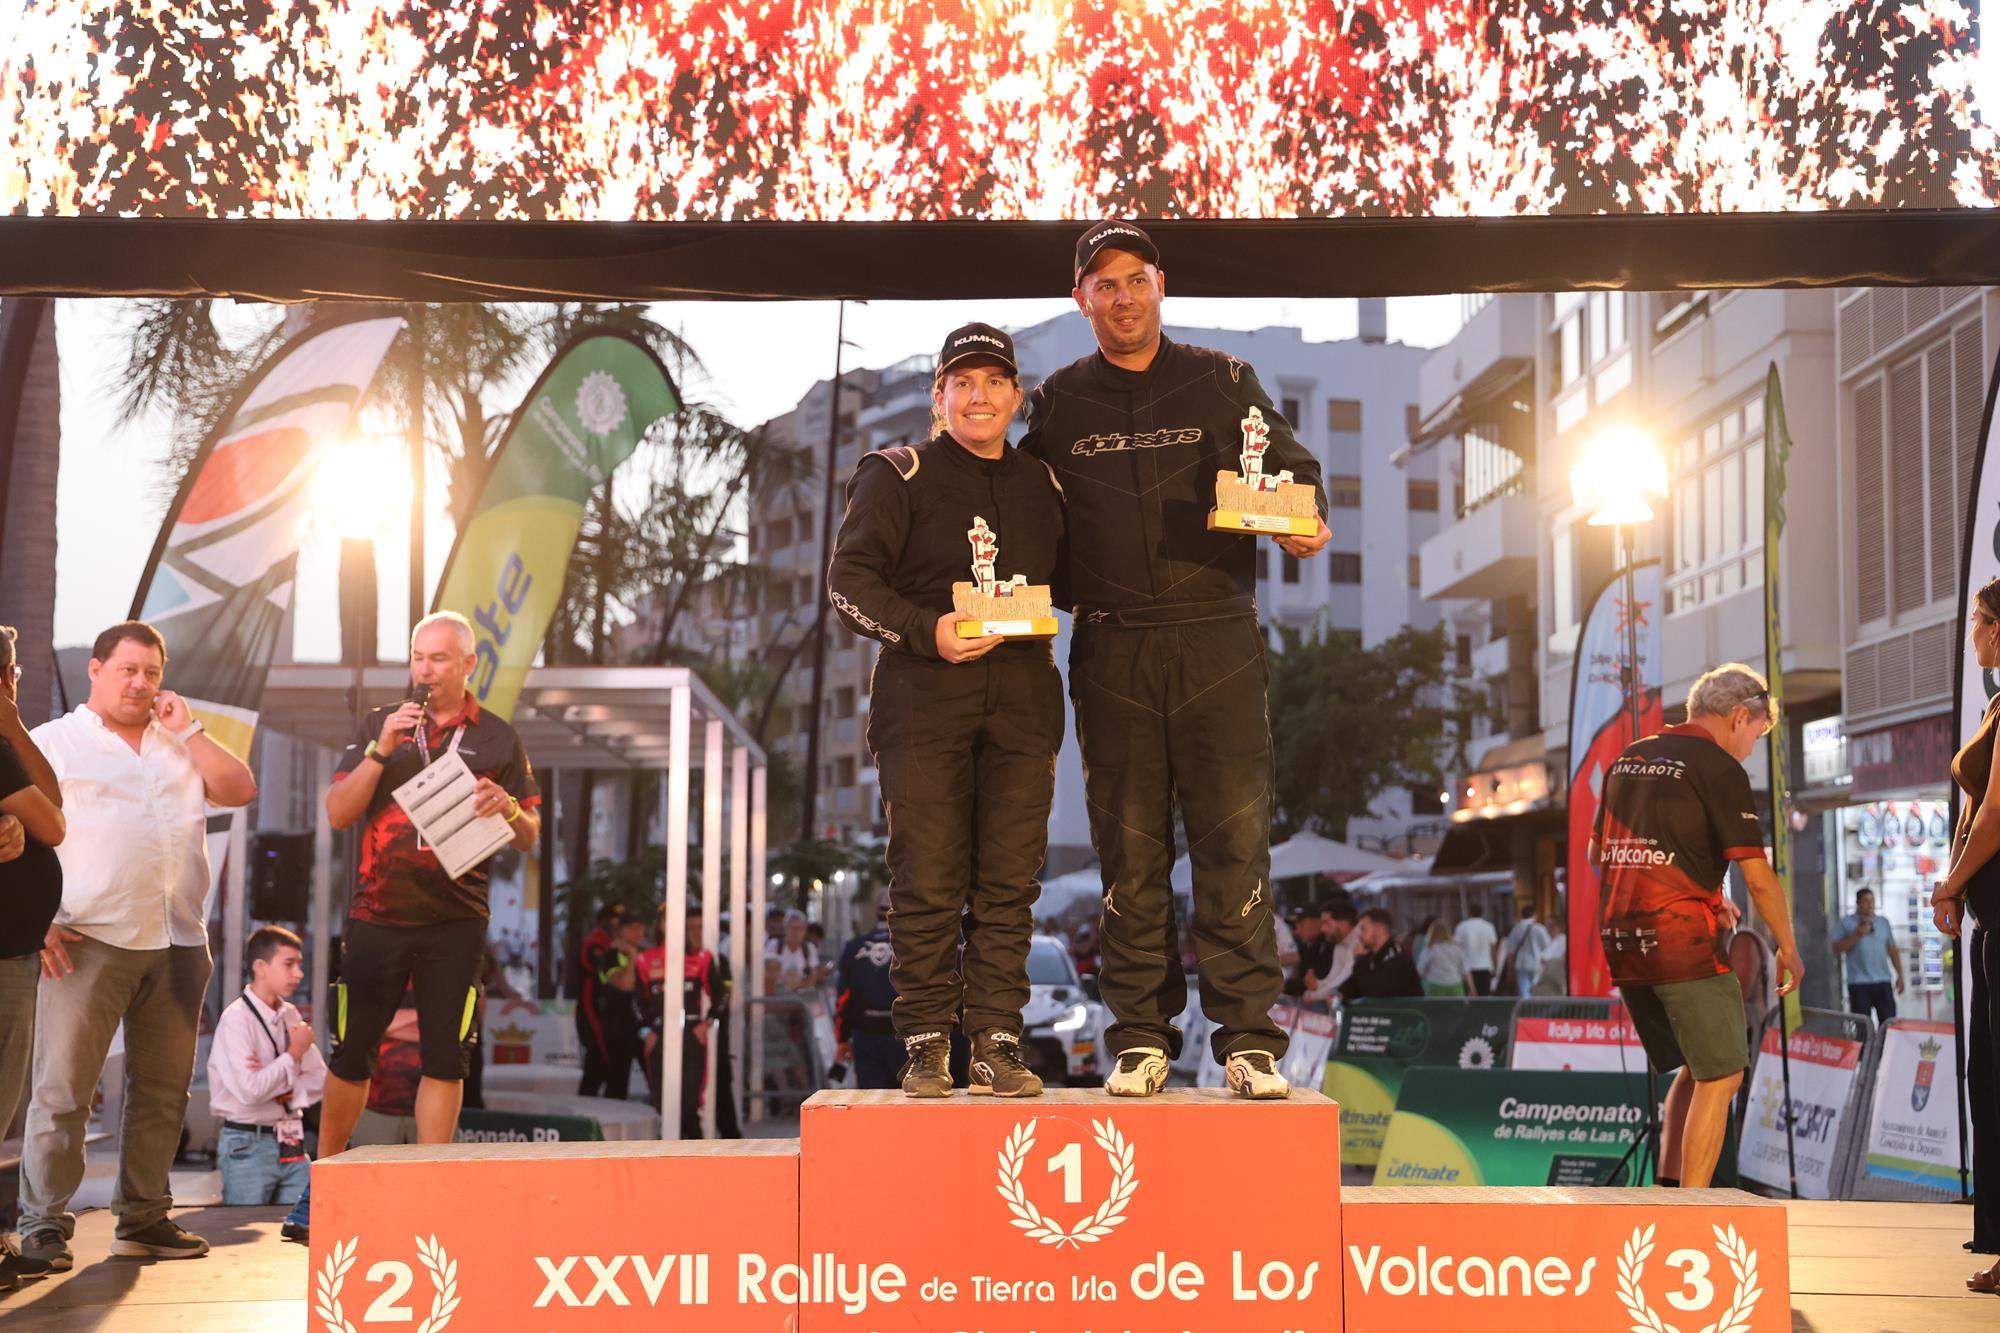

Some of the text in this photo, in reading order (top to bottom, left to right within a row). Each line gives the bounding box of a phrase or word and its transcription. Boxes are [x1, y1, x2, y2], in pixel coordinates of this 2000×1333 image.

[1088, 227, 1139, 245] KUMHO
[954, 334, 1005, 349] KUMHO
[1612, 763, 1684, 779] LANZAROTE
[1499, 1097, 1642, 1125] Campeonato
[1493, 1124, 1512, 1139] de
[1514, 1124, 1566, 1144] Rallyes
[1568, 1126, 1588, 1142] de
[1589, 1127, 1616, 1143] Las
[1047, 1143, 1082, 1203] 1
[363, 1260, 414, 1323] 2
[532, 1245, 1597, 1315] XXVII Rallye de Tierra Isla de Los Volcanes
[1664, 1248, 1715, 1312] 3
